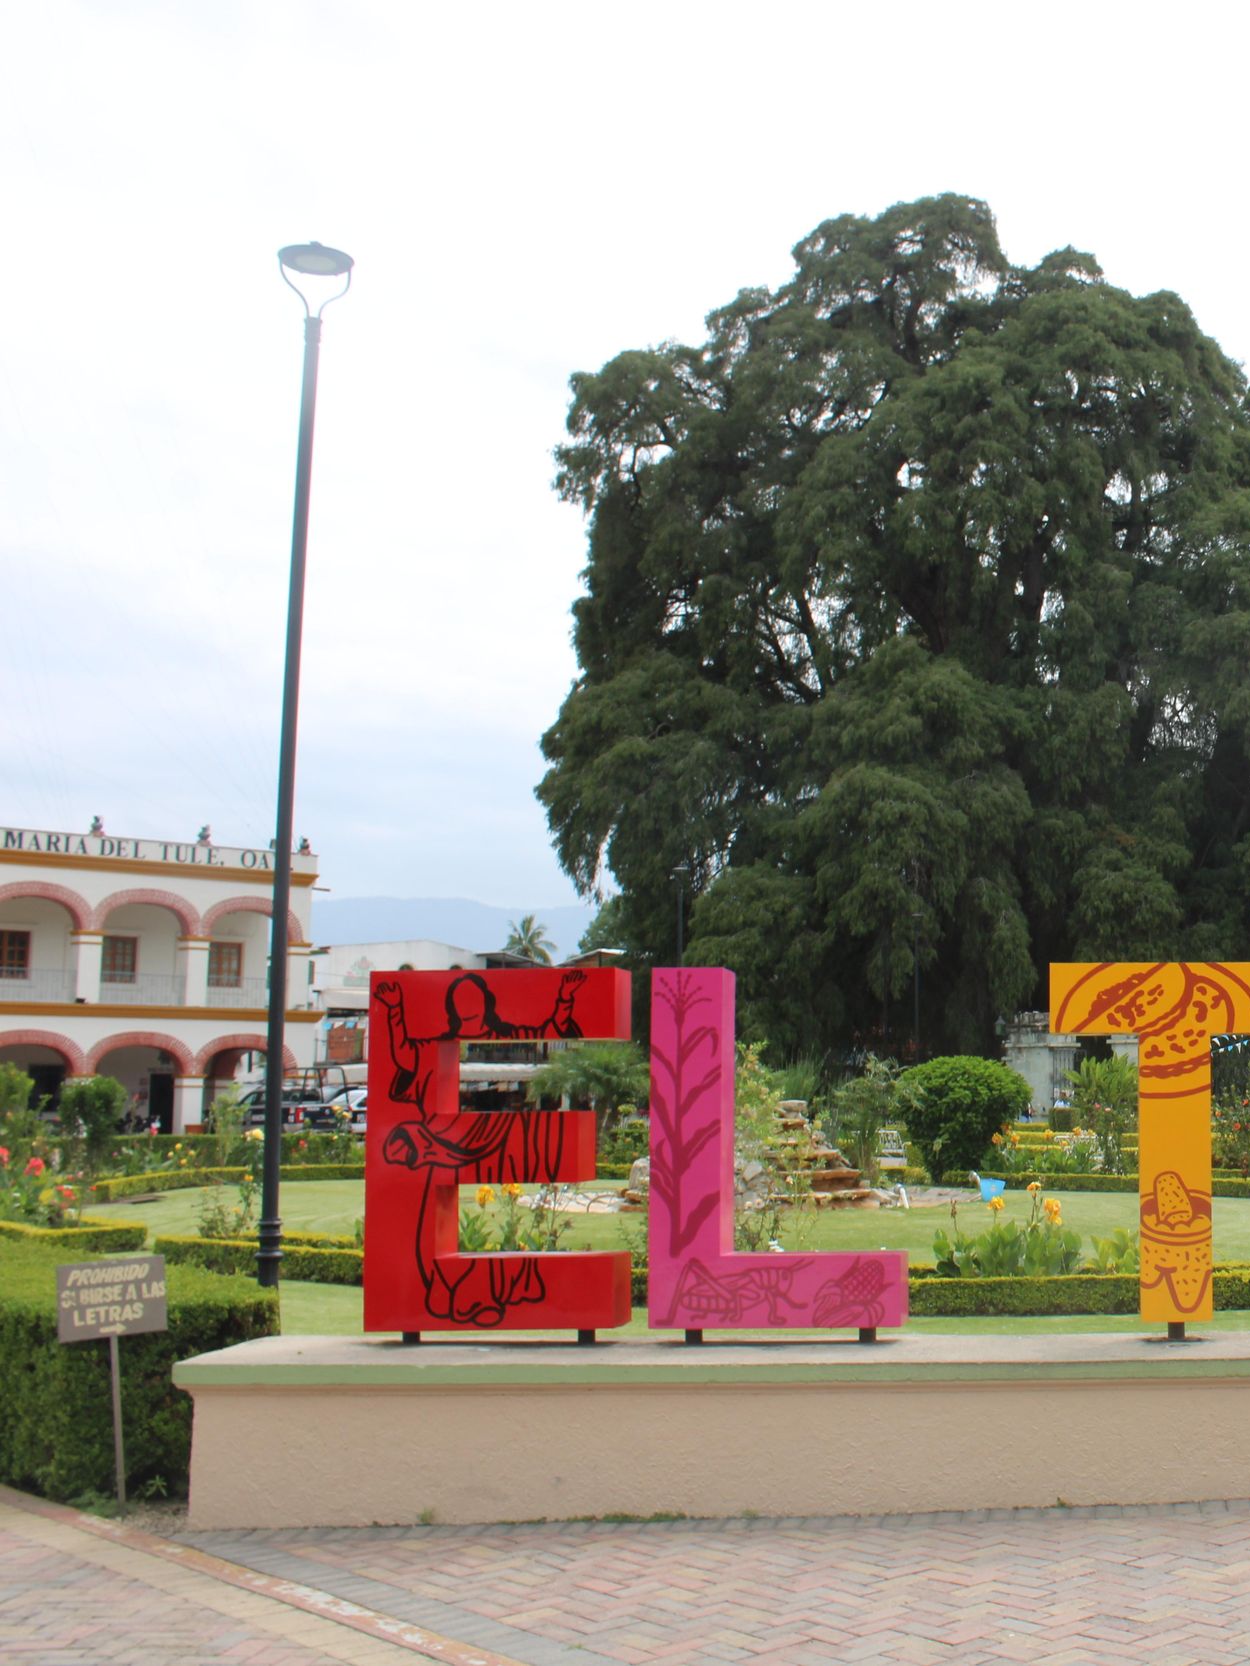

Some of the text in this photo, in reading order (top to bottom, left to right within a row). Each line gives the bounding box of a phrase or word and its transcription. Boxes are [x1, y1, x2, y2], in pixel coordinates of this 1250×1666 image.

[3, 830, 87, 855] MARIA
[100, 839, 146, 859] DEL
[364, 966, 910, 1332] EL
[66, 1263, 150, 1287] PROHIBIDO
[126, 1284, 137, 1300] A
[142, 1281, 165, 1299] LAS
[73, 1302, 144, 1327] LETRAS
